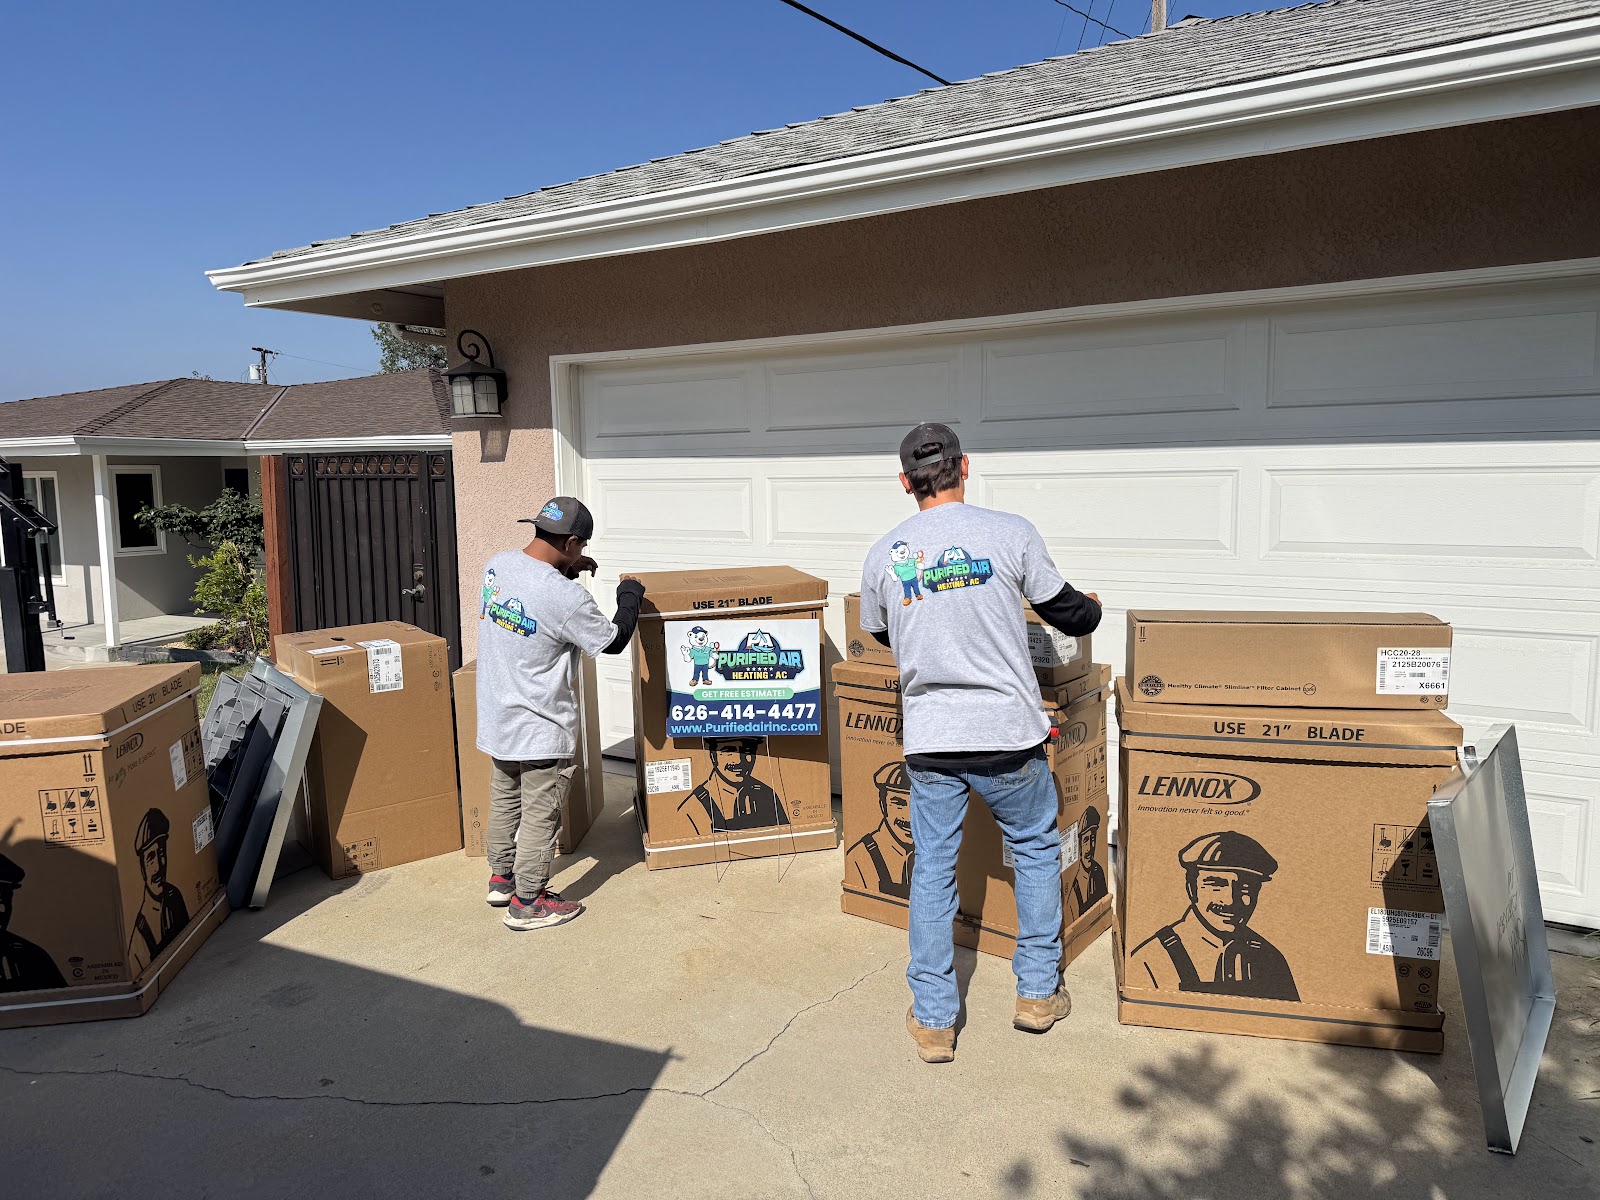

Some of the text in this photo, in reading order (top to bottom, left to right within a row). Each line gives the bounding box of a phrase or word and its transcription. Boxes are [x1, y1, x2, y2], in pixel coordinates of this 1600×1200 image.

[923, 561, 991, 585] PURIFIED AIR
[937, 578, 980, 591] HEATING AC
[692, 596, 773, 610] USE 21" BLADE
[490, 603, 536, 630] PURIFIED AIR
[717, 651, 801, 669] PURIFIED AIR
[732, 671, 788, 680] HEATING AC
[132, 697, 146, 712] USE
[161, 677, 183, 697] BLADE
[701, 689, 786, 698] GET FREE ESTIMATE!
[671, 703, 816, 721] 626-414-4477
[671, 721, 818, 734] www.Purifiedairinc.com
[1213, 721, 1246, 735] USE
[1307, 726, 1365, 741] BLADE
[116, 734, 140, 759] LENNOX
[1137, 775, 1238, 799] LENNOX
[1137, 804, 1178, 813] Innovation
[1179, 806, 1200, 814] never
[1200, 807, 1213, 815] felt
